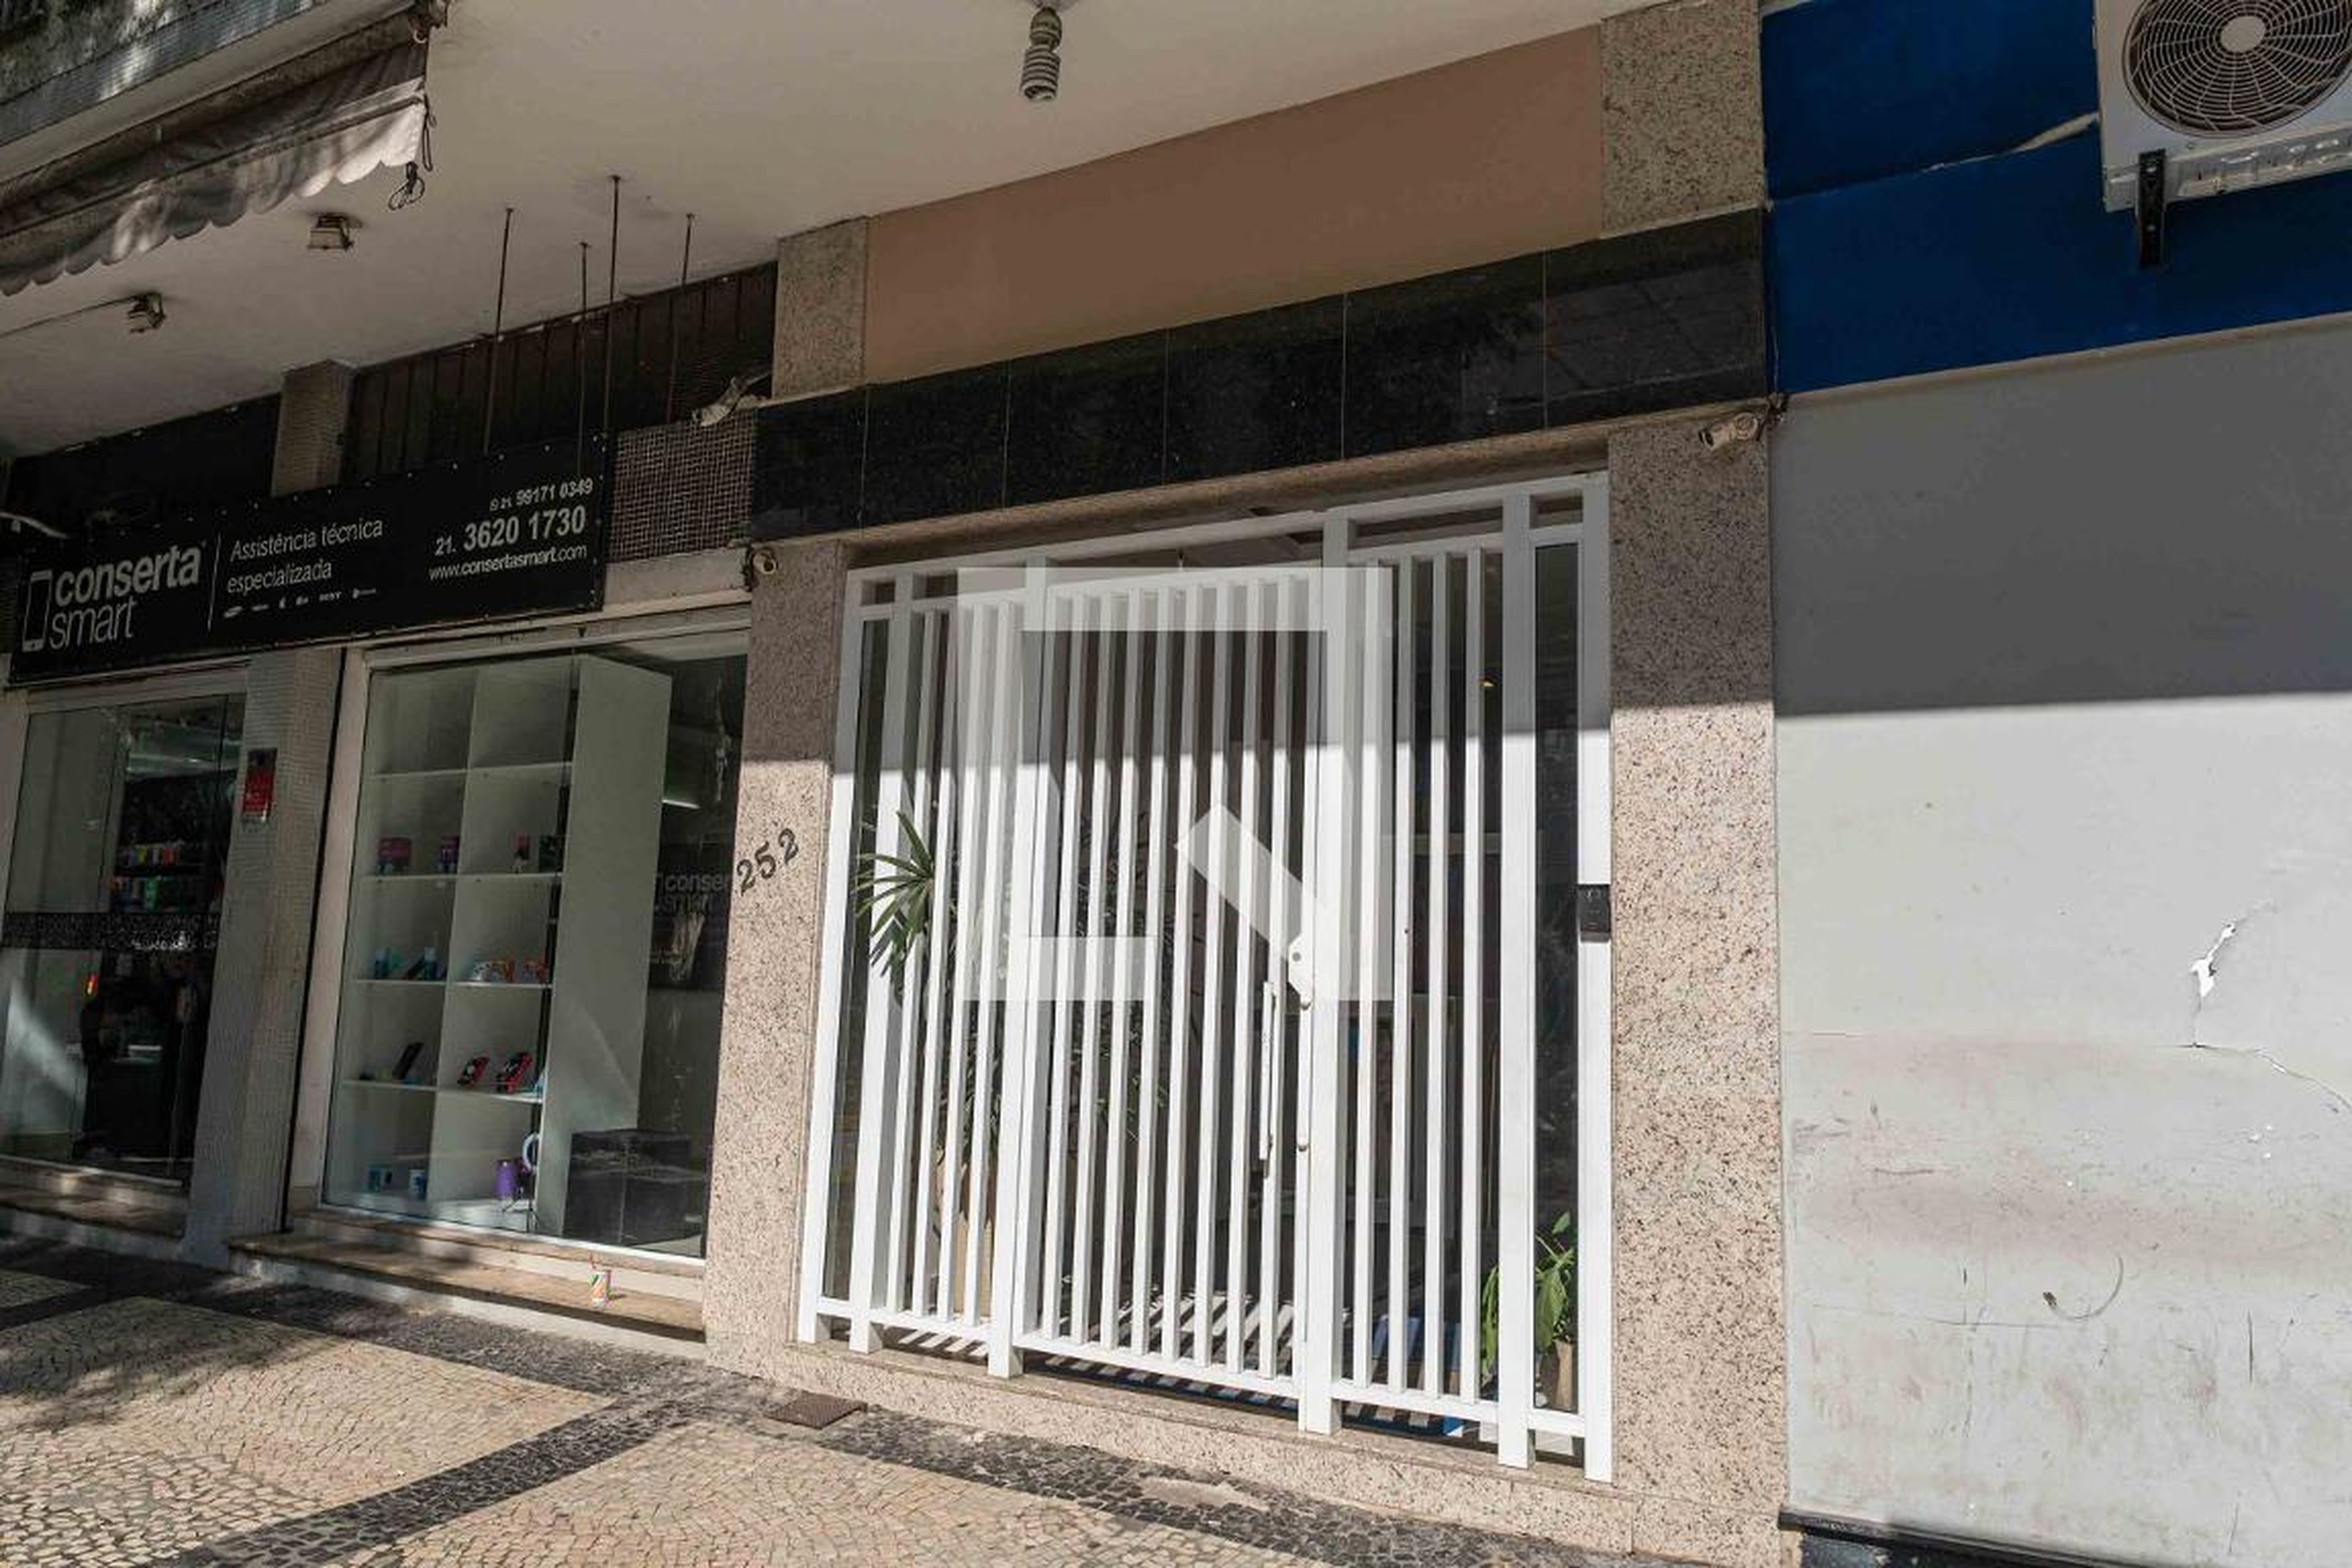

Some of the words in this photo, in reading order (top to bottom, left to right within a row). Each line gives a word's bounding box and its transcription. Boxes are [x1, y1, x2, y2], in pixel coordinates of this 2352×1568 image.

[516, 483, 556, 507] 99171
[230, 527, 317, 562] Assistência
[322, 516, 384, 548] técnica
[464, 516, 520, 551] 3620
[529, 505, 586, 541] 1730
[55, 544, 201, 606] conserta
[227, 557, 333, 597] especializada
[429, 543, 587, 581] www.consertasmart.com
[49, 599, 137, 650] smart
[736, 828, 799, 897] 252
